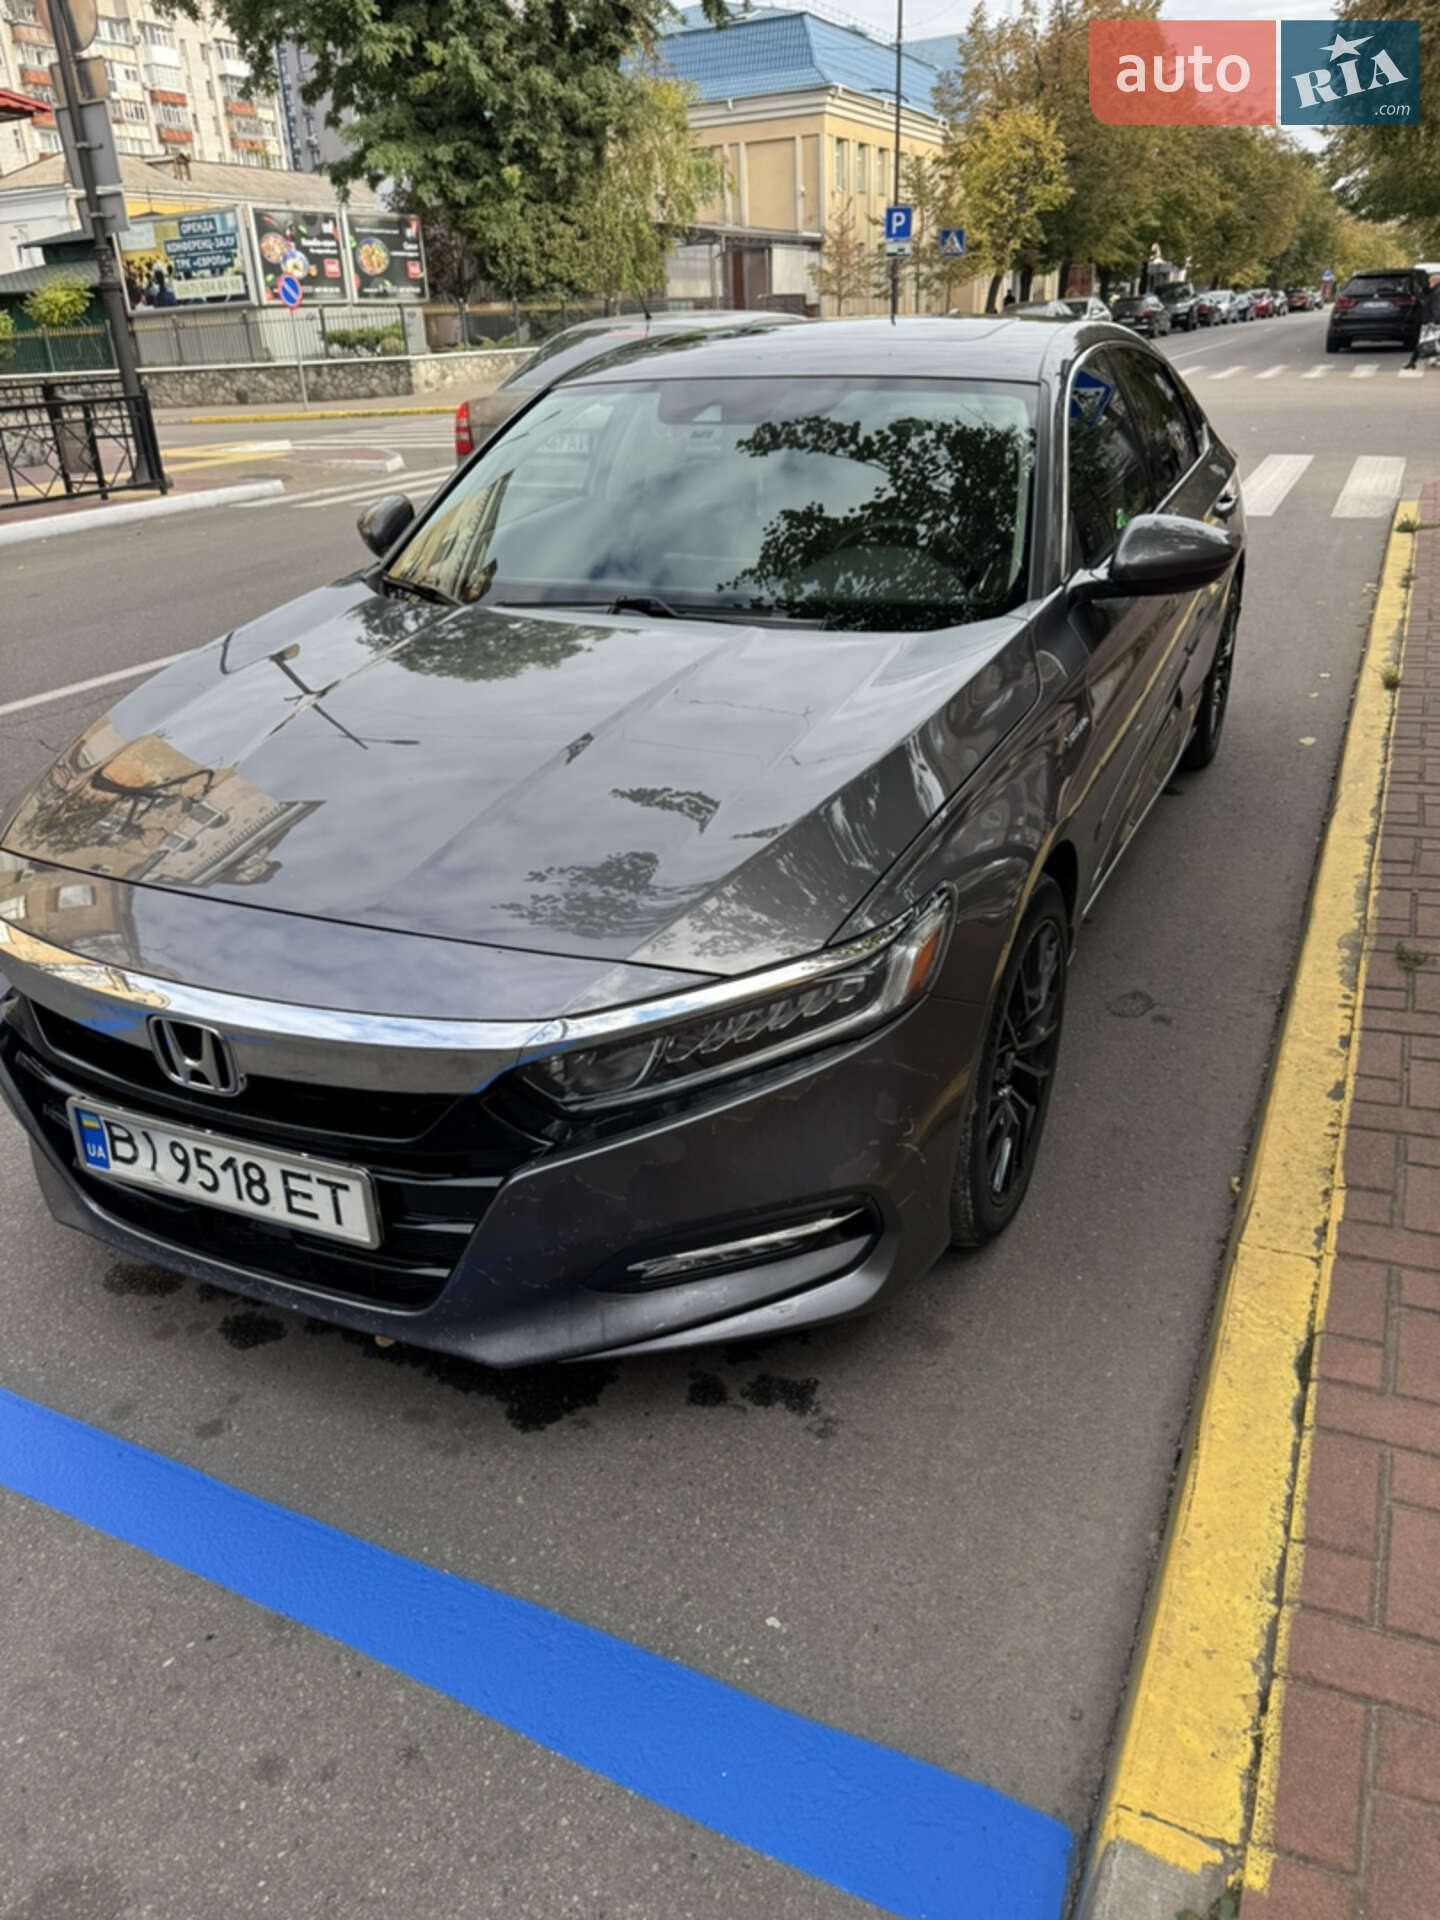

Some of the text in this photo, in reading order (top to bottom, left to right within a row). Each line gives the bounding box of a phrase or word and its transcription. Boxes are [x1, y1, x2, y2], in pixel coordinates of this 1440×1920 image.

[180, 220, 215, 236] ОРЕНДА
[891, 211, 906, 235] P
[87, 1142, 107, 1160] UA
[169, 1140, 271, 1207] 9518
[280, 1168, 350, 1226] ET
